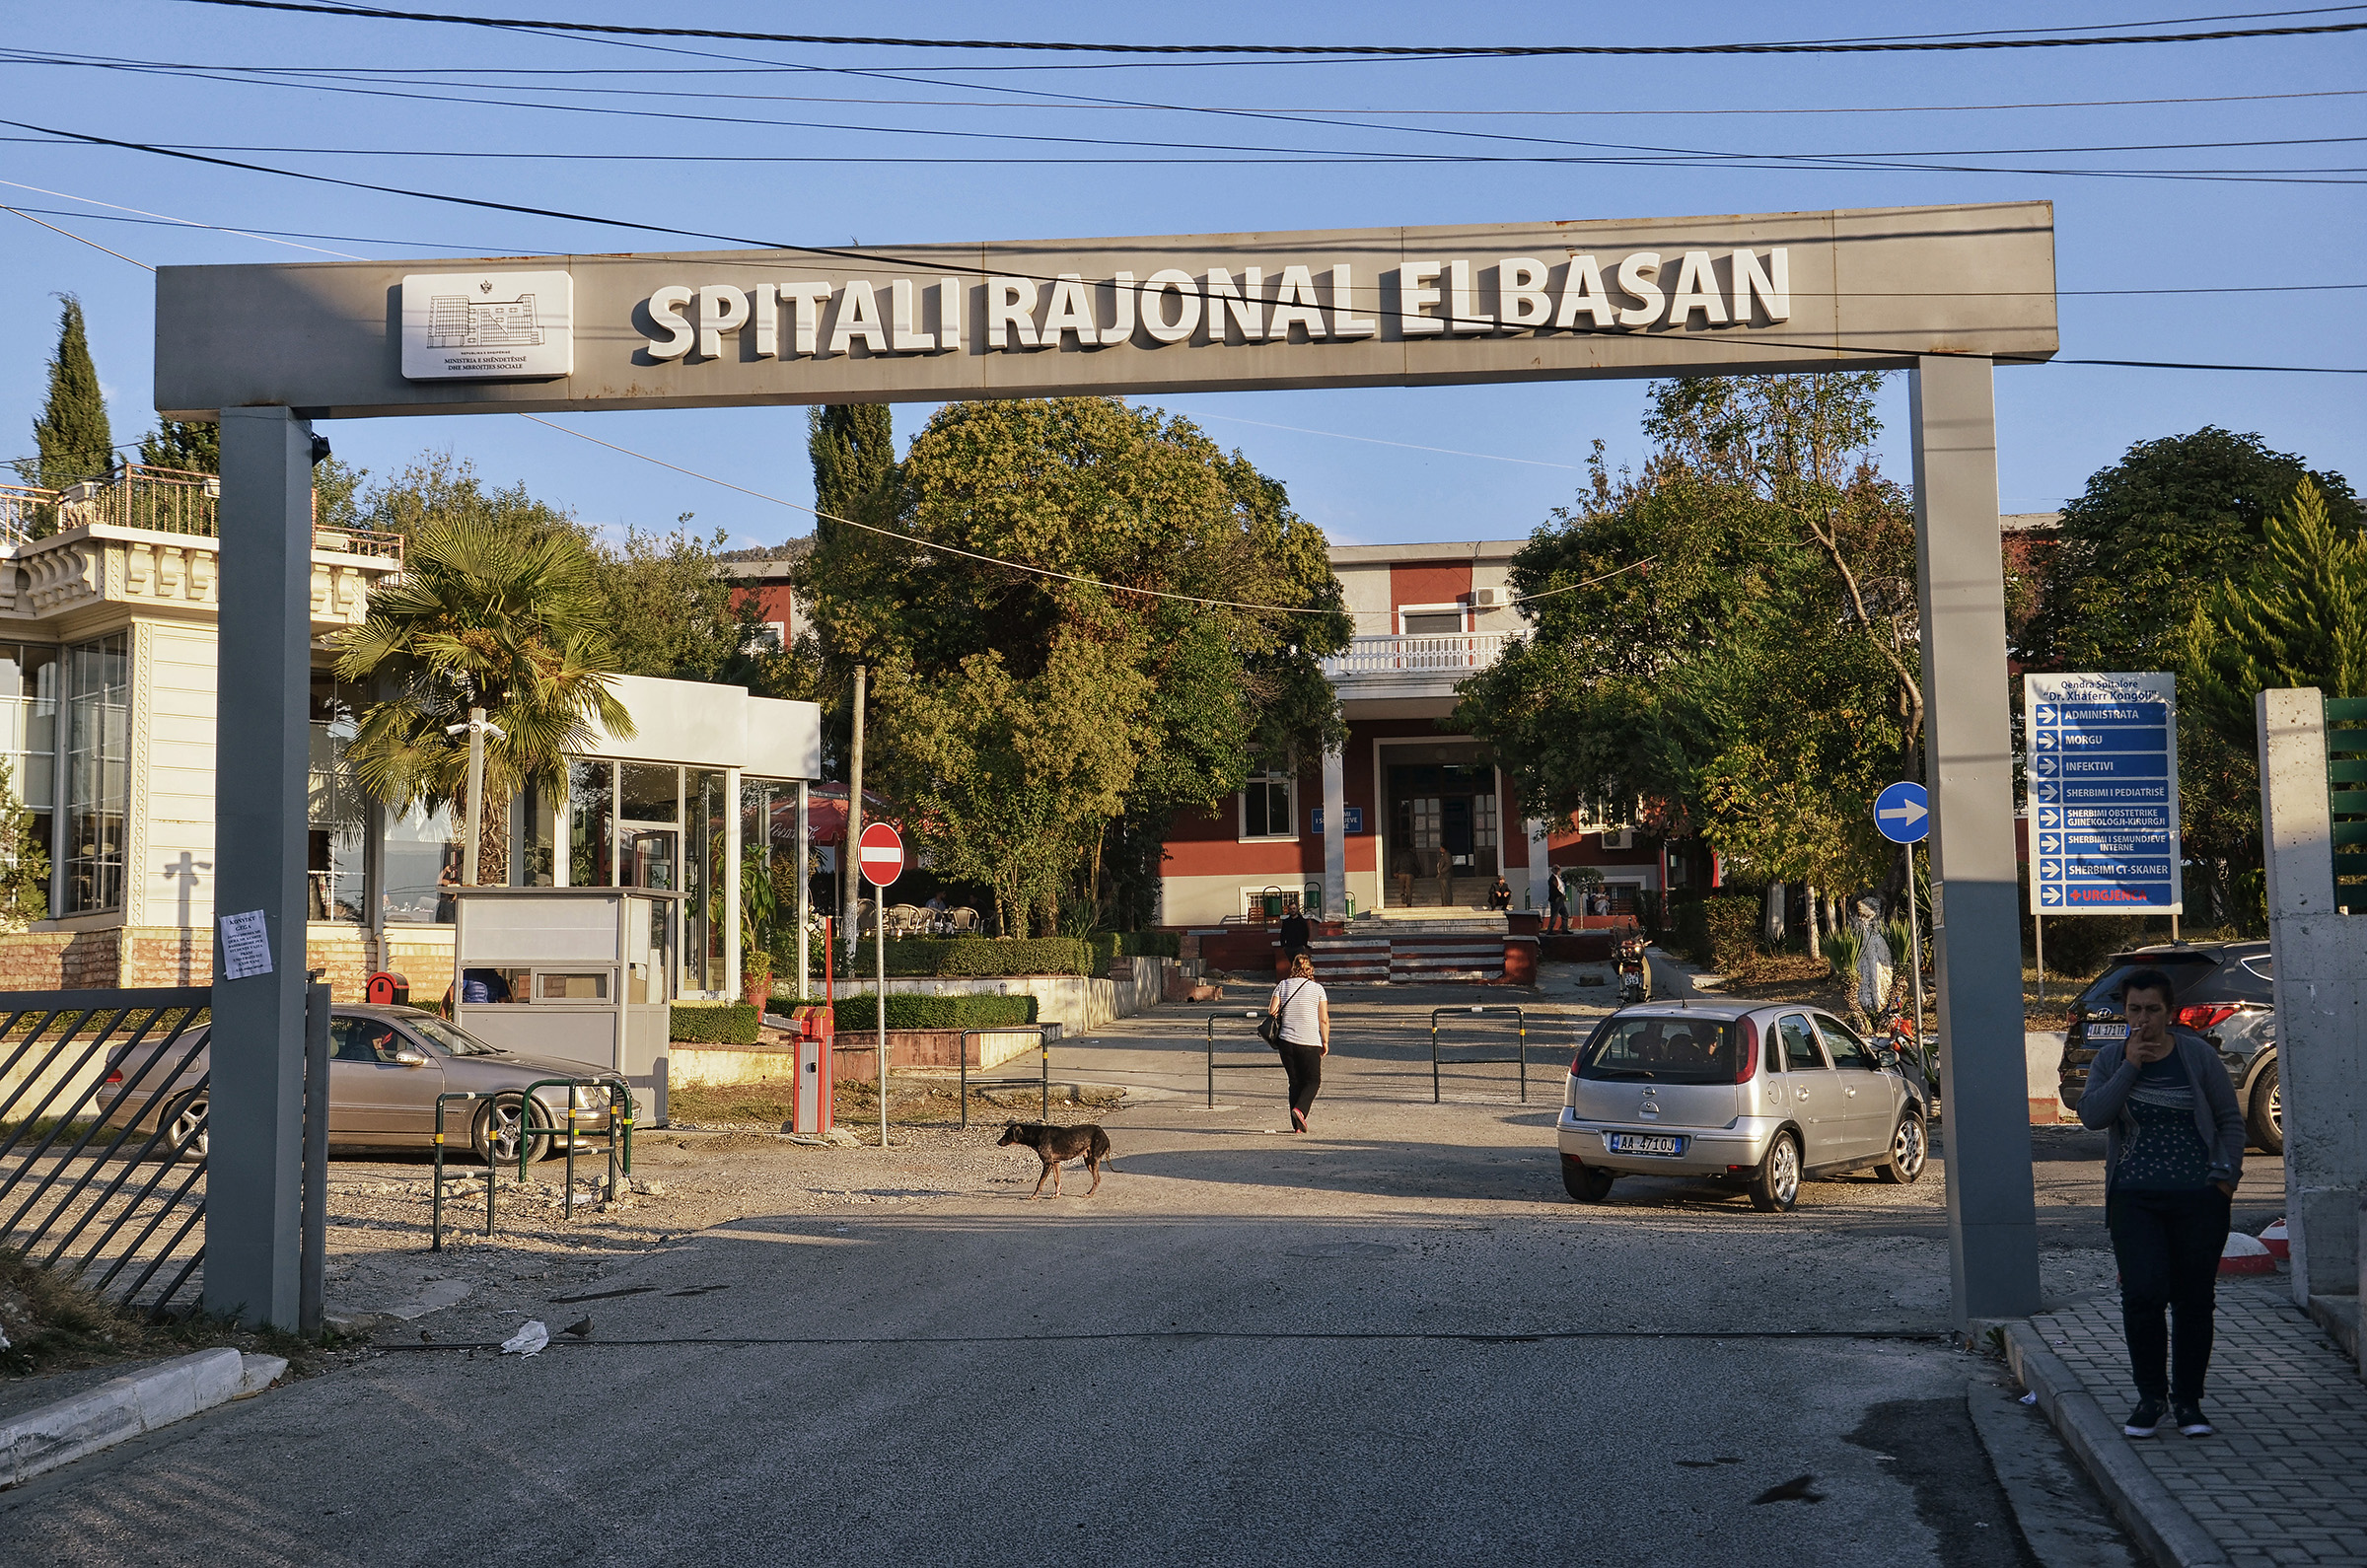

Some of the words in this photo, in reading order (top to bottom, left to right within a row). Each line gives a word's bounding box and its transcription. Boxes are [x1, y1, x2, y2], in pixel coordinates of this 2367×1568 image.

[646, 276, 961, 361] SPITALI
[987, 263, 1376, 350] RAJONAL
[1399, 248, 1790, 336] ELBASAN
[2060, 680, 2095, 689] Qendra
[2096, 677, 2138, 689] Spitalore
[2066, 690, 2108, 701] Xhaferr
[2064, 709, 2139, 720] ADMINISTRATA
[2065, 735, 2103, 745] MORGU
[2065, 761, 2114, 771] INFEKTIVI
[2066, 788, 2109, 797] SHERBIMI
[2115, 786, 2165, 797] PEDIATRISË
[2067, 818, 2166, 826] GJINEKOLOGJI-KIRURGJI
[2068, 835, 2108, 844] SHERBIMI
[2113, 834, 2166, 843] SEMUNDJEVE
[2068, 866, 2115, 875] SHERBIMI
[2116, 865, 2169, 875] CT-SKANER
[2082, 890, 2147, 901] URGJENCA
[1620, 1136, 1634, 1149] AA
